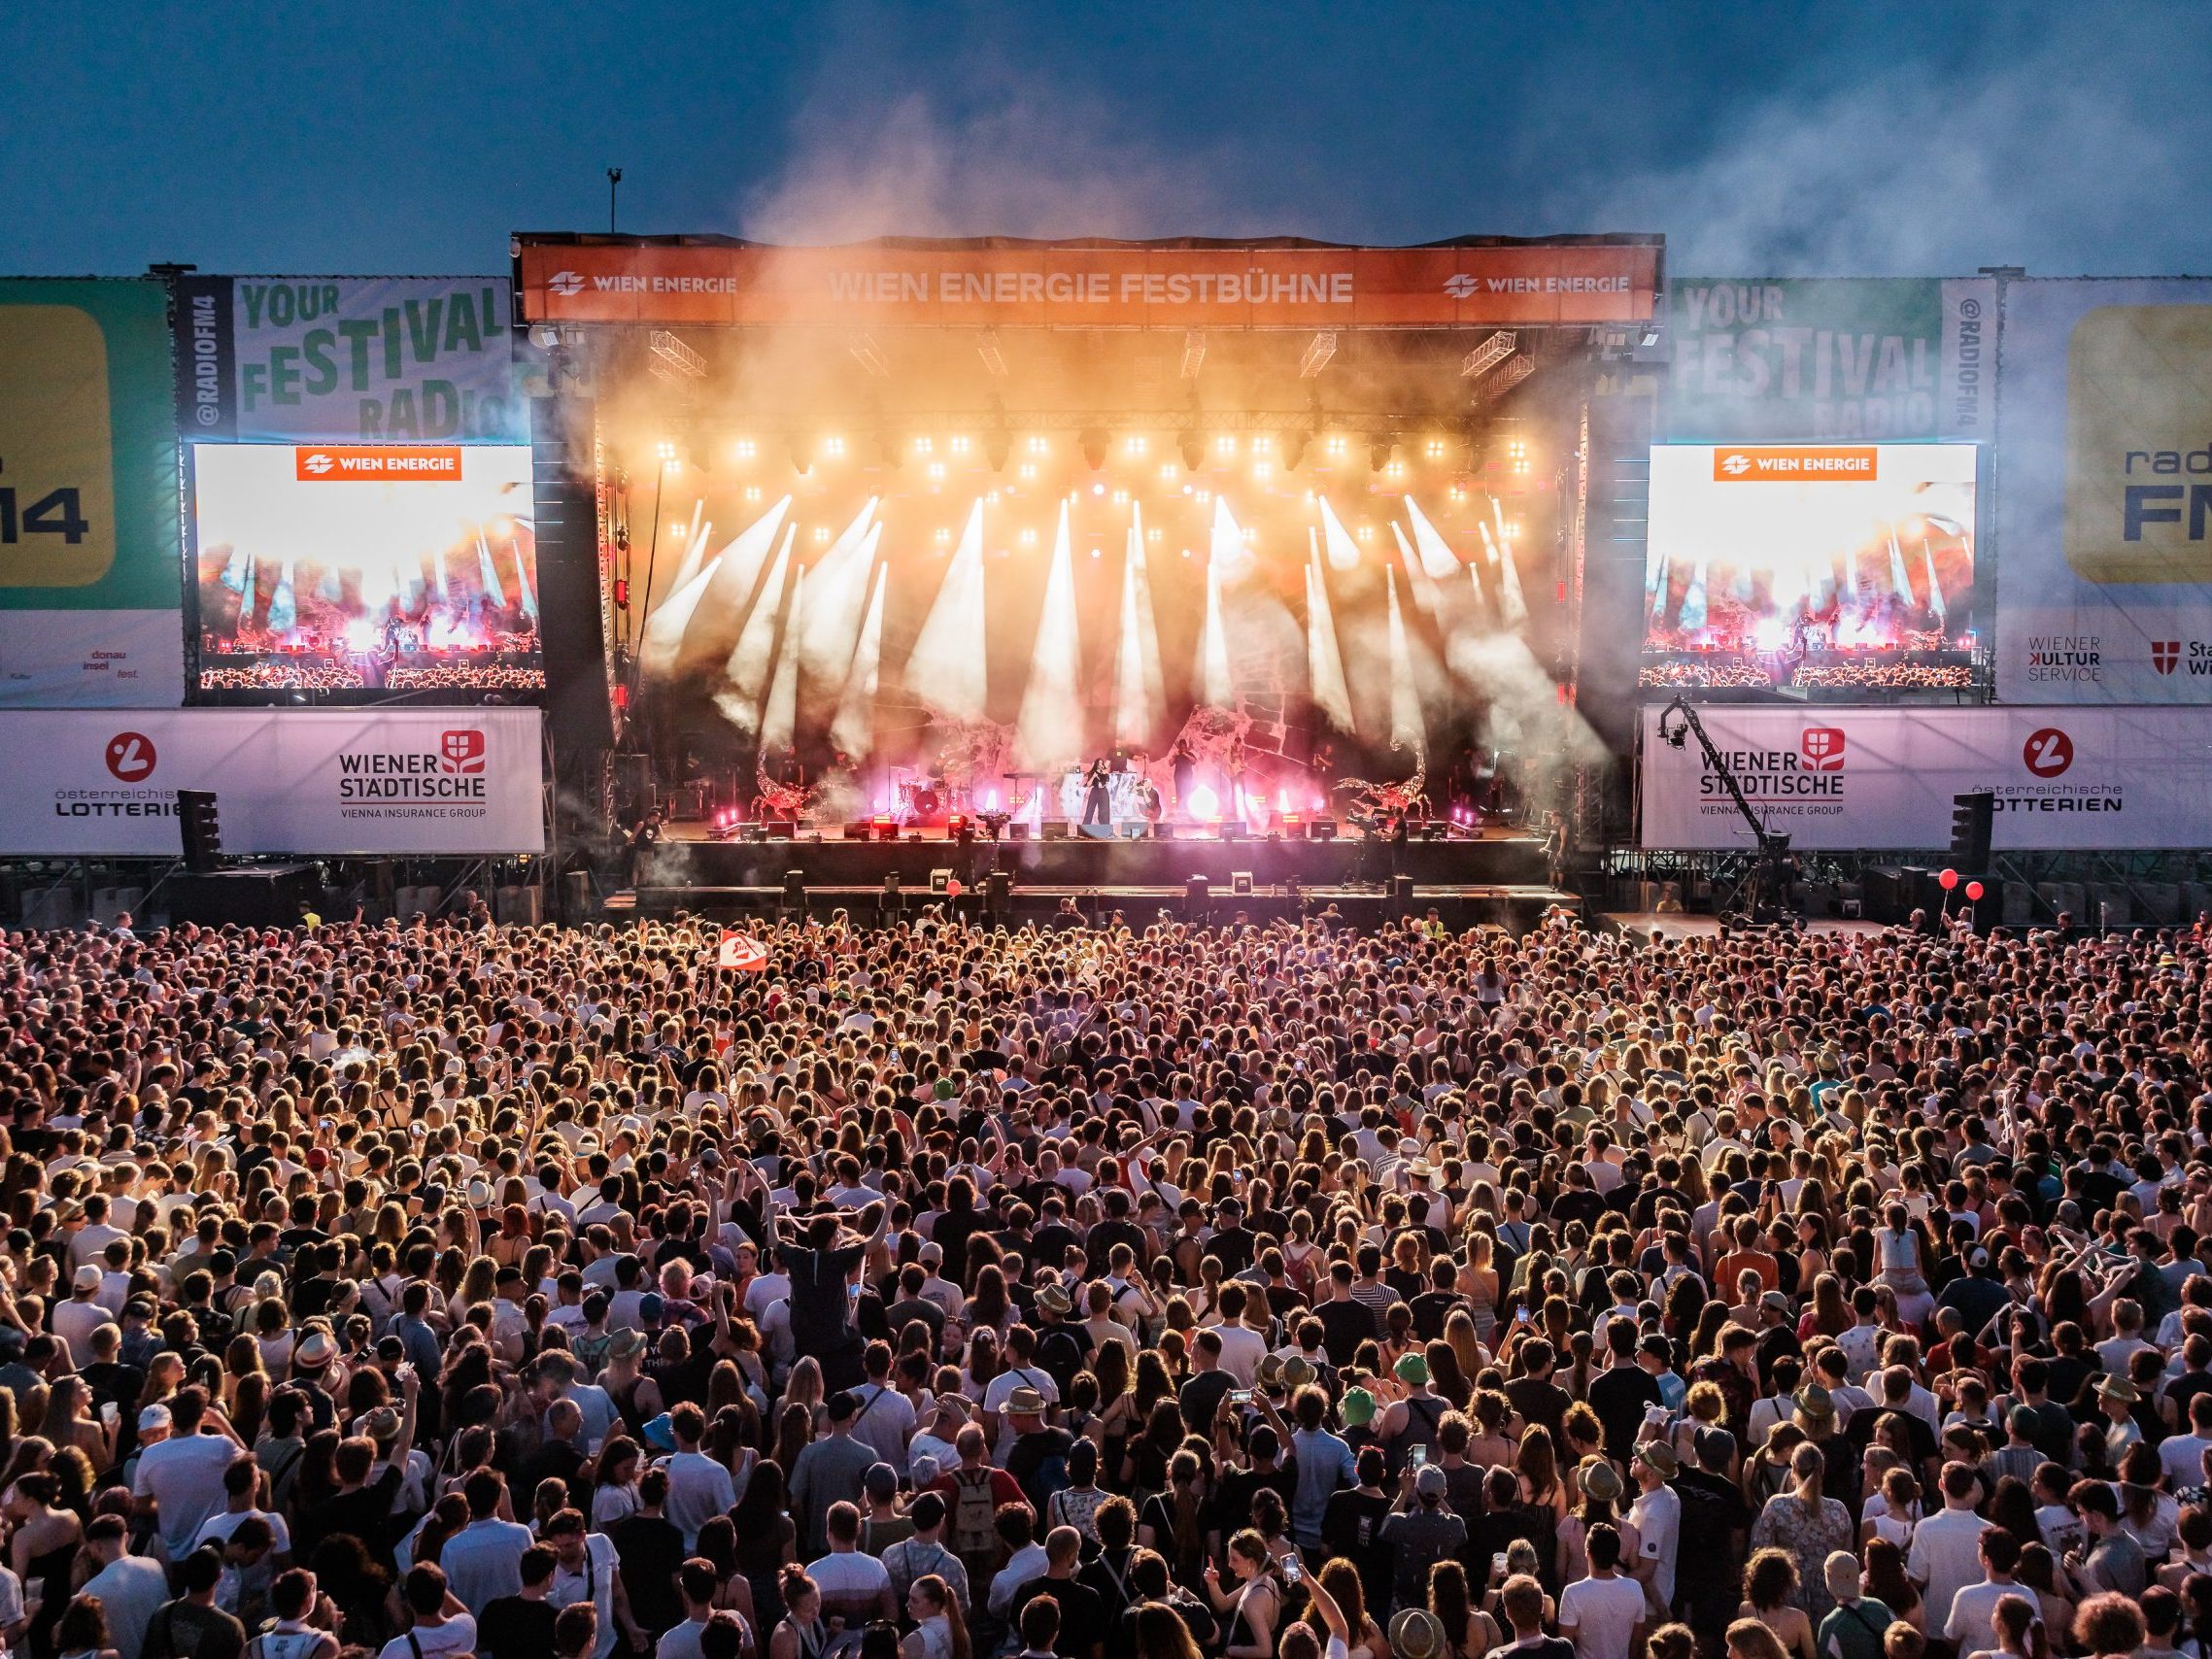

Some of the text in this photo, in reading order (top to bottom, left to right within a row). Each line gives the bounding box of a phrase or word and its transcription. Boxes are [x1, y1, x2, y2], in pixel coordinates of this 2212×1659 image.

[593, 276, 736, 294] WIEN ENERGIE
[828, 267, 1353, 303] WIEN ENERGIE FESTBÜHNE
[1486, 276, 1629, 293] WIEN ENERGIE
[241, 284, 340, 329] YOUR
[1685, 285, 1784, 330] YOUR
[243, 288, 504, 412] FESTIVAL
[192, 294, 220, 426] @RADIOFM4
[1675, 327, 1934, 399] FESTIVAL
[1957, 297, 1982, 427] @RADIOFM4
[359, 380, 507, 440] RADIO
[1814, 390, 1933, 438] RADIO
[339, 457, 455, 470] WIEN ENERGIE
[1756, 457, 1870, 471] WIEN ENERGIE
[2028, 637, 2100, 650] WIENER
[91, 651, 126, 660] donau
[83, 661, 109, 670] insel
[2028, 668, 2101, 681] SERVICE
[340, 755, 438, 773] WIENER
[55, 789, 175, 799] österreichis
[340, 778, 486, 796] STÄDTISCHE
[341, 808, 486, 818] VIENNA INSURANCE GROUP
[1701, 806, 1740, 815] VIENNA
[1807, 806, 1843, 815] GROUP
[1992, 798, 2122, 811] OTTERIEN
